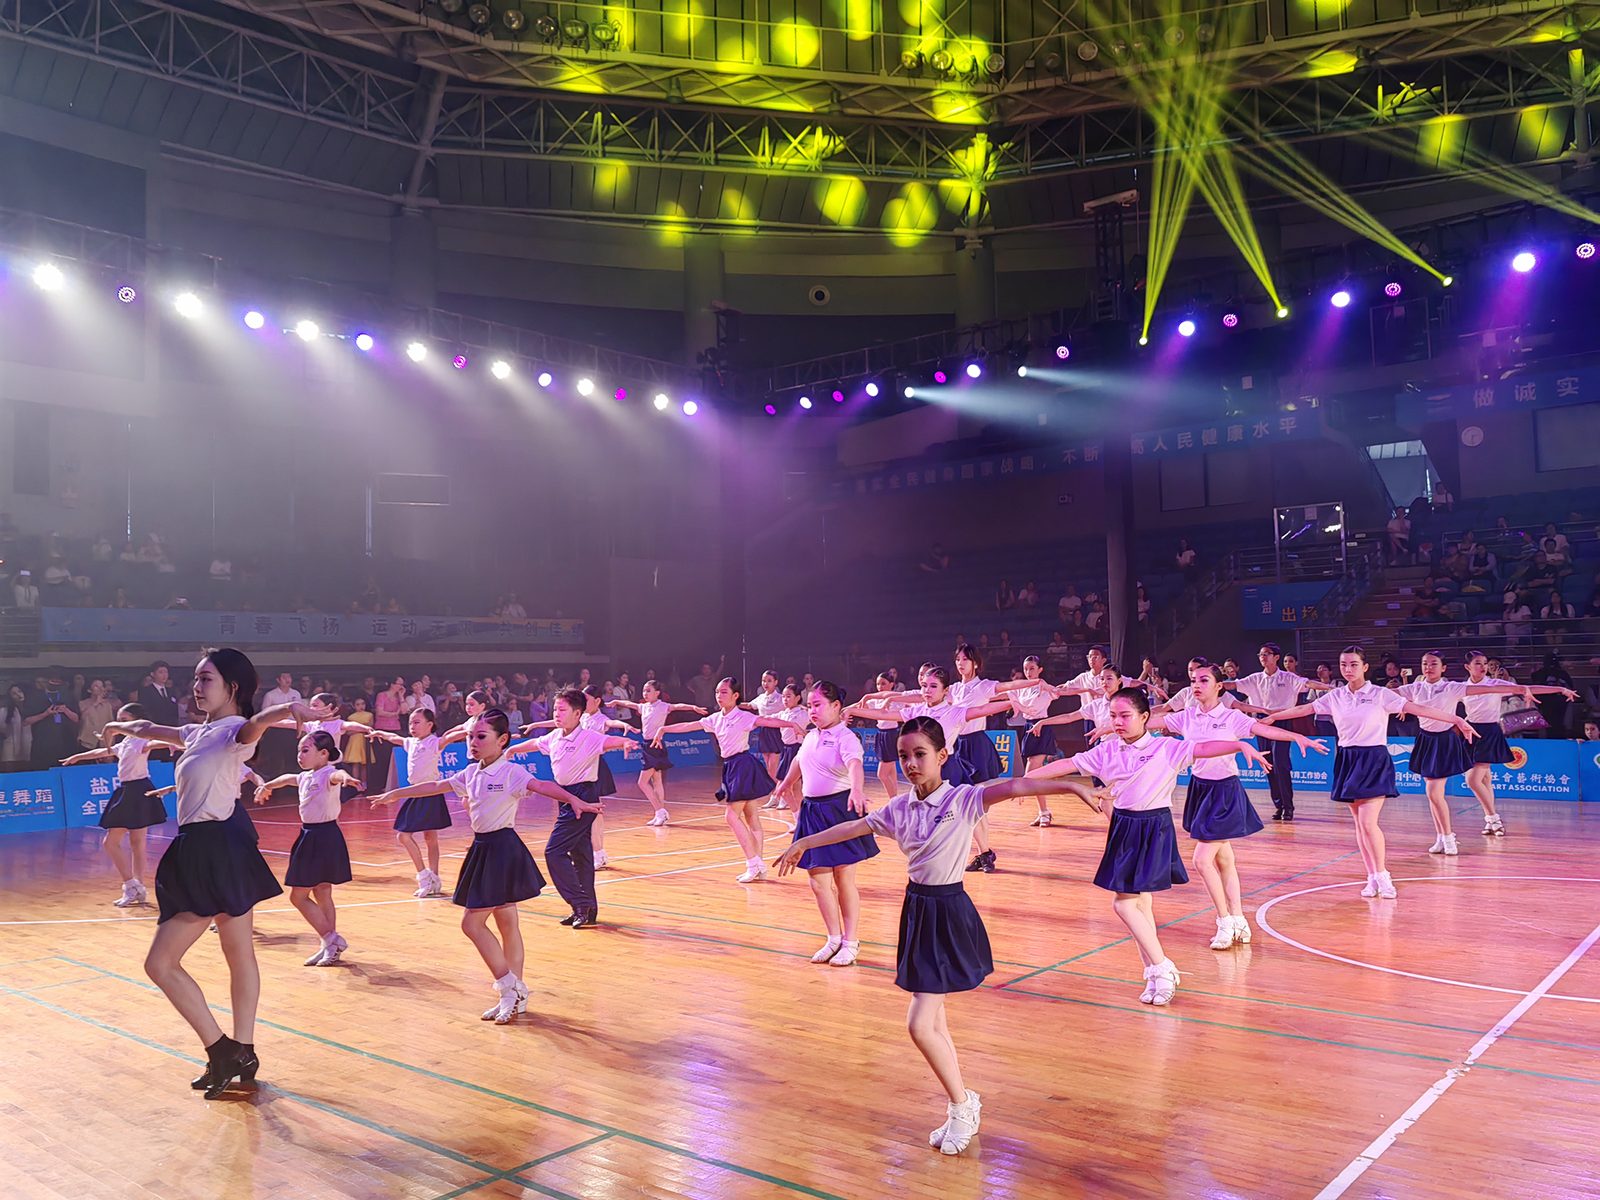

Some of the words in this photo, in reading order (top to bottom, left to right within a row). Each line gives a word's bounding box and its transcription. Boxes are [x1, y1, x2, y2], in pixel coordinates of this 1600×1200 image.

[1474, 377, 1580, 408] 做诚实
[218, 615, 340, 636] 青春飞扬
[1508, 785, 1570, 793] ASSOCIATION
